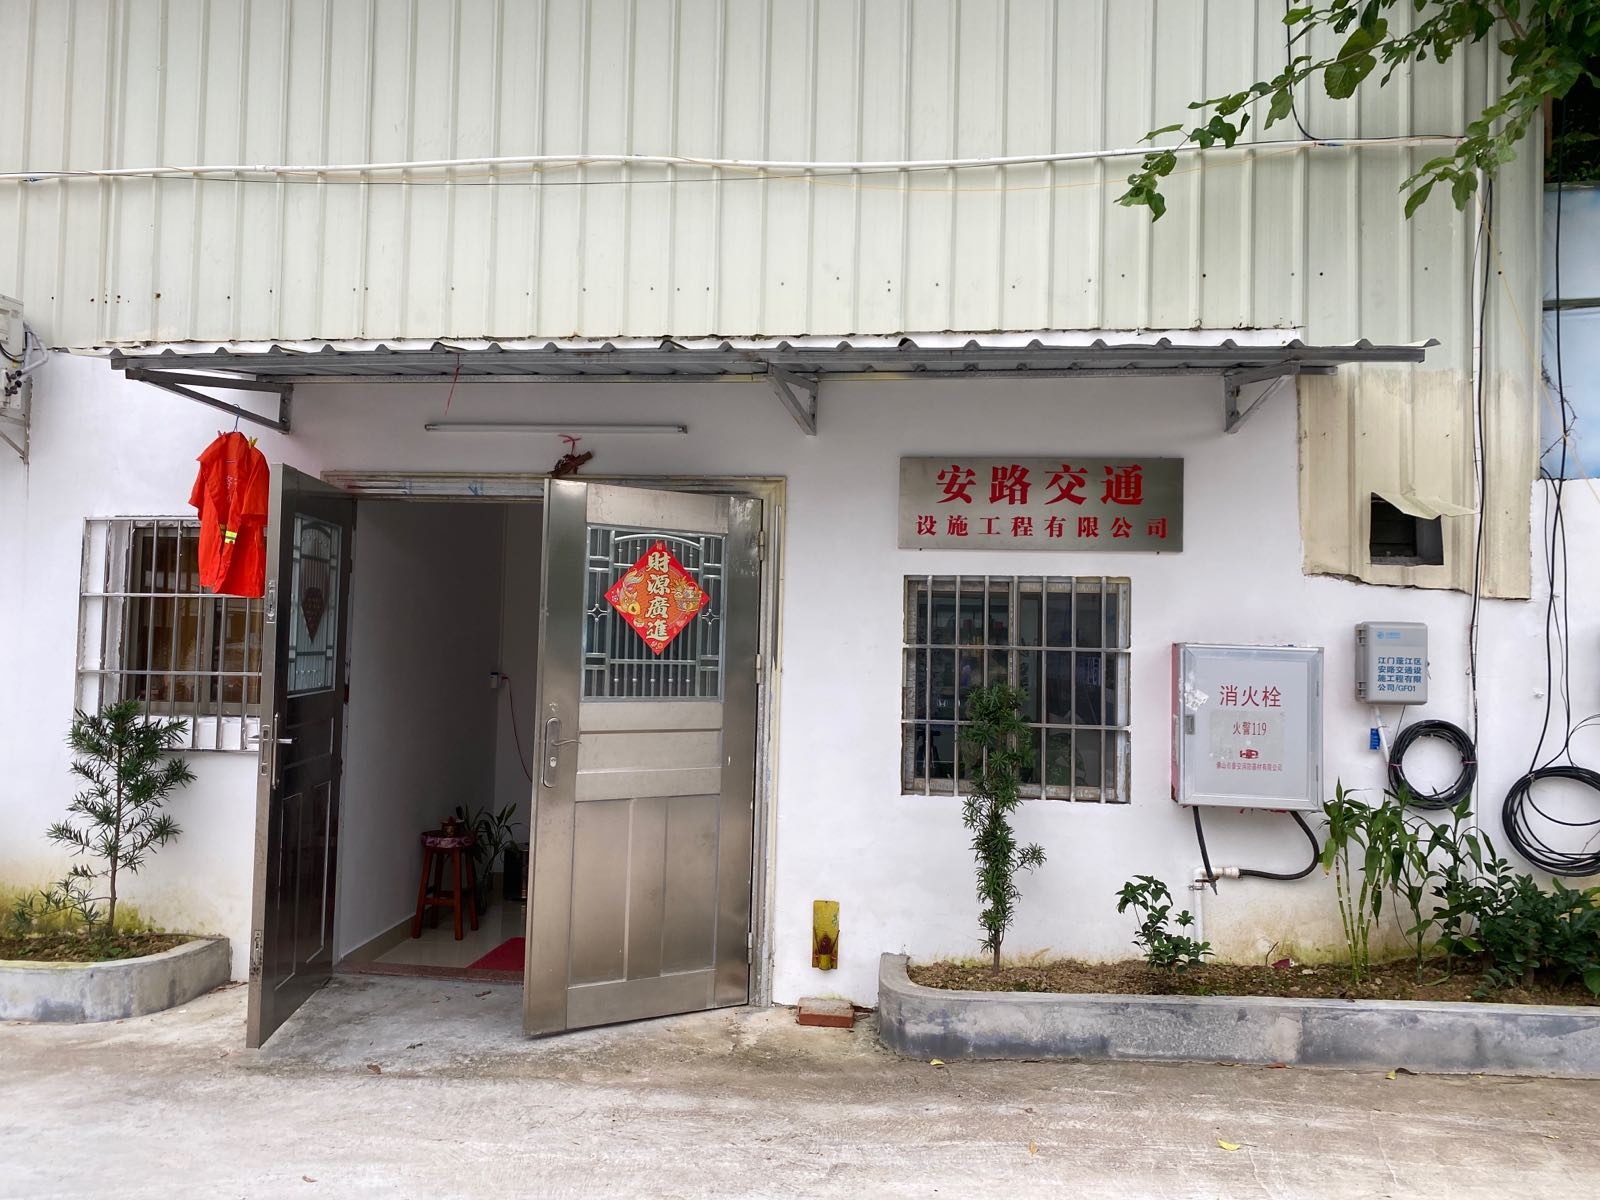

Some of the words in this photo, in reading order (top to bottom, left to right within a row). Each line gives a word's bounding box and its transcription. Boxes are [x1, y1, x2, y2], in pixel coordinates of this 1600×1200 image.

[936, 464, 1145, 506] 安路交通
[916, 514, 1168, 540] 设施工程有限公司
[645, 551, 671, 641] 財源廣進
[1377, 656, 1422, 666] 江门蓬江区
[1377, 665, 1422, 675] 安路交通设
[1377, 674, 1422, 684] 施工程有限
[1377, 683, 1416, 692] 公司/GF01
[1219, 684, 1282, 708] 消火栓
[1232, 721, 1267, 736] 火警119
